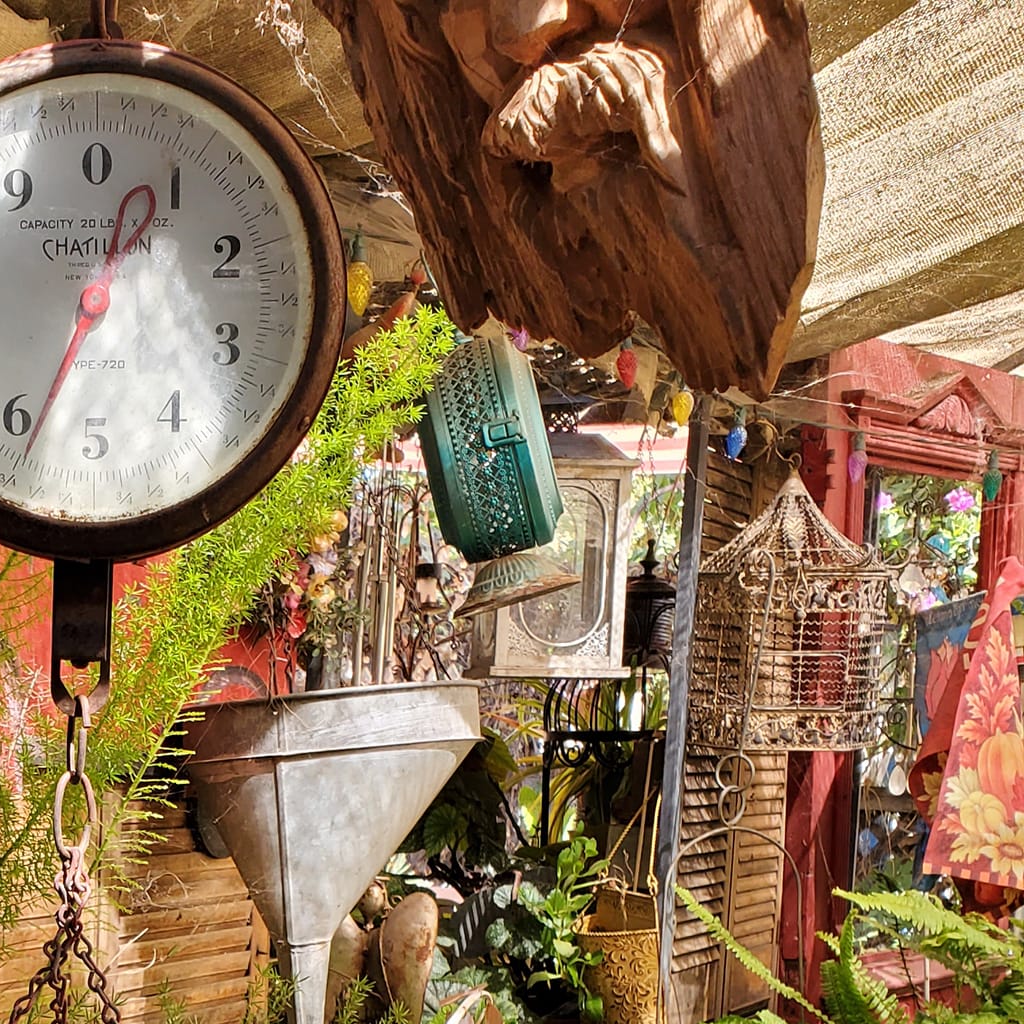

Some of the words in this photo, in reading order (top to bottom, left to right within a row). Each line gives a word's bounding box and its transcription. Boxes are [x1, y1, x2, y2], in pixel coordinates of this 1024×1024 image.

[82, 142, 113, 185] 0
[247, 174, 265, 190] 1/2
[3, 168, 33, 212] 9
[168, 163, 181, 210] 1
[19, 219, 74, 230] CAPACITY
[80, 218, 96, 229] 20
[100, 217, 127, 229] LB.
[131, 218, 139, 228] X
[152, 217, 175, 228] OZ.
[212, 234, 241, 279] 2
[281, 292, 298, 307] 1/2
[71, 359, 126, 370] YPE-720
[212, 322, 241, 366] 3
[2, 393, 32, 436] 6
[156, 389, 188, 433] 4
[243, 408, 261, 423] 1/2
[81, 417, 109, 460] 5
